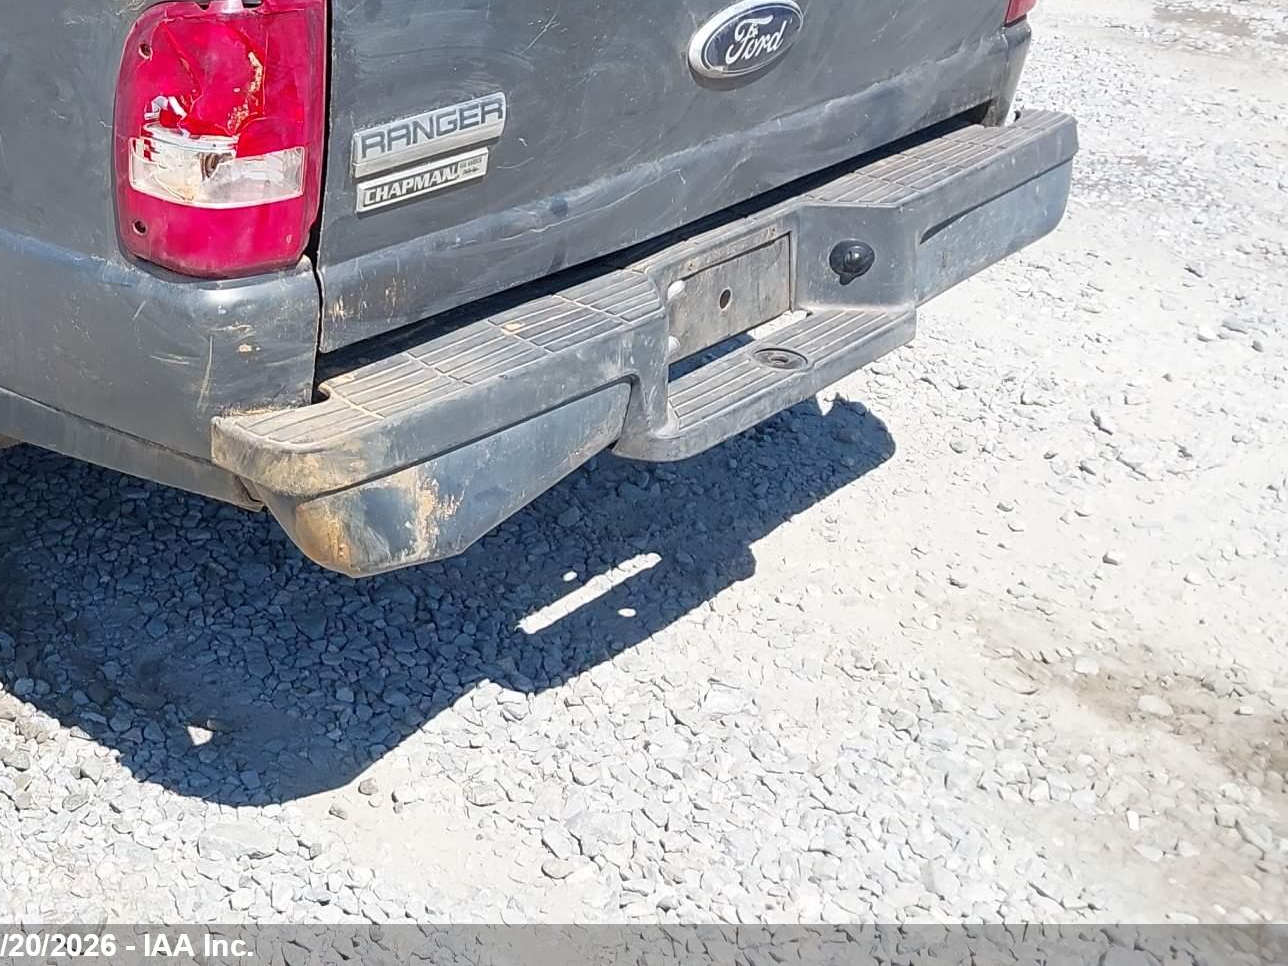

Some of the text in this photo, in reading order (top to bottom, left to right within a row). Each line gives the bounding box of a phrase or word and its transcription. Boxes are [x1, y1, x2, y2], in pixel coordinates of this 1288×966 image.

[725, 14, 787, 65] Ford
[362, 99, 503, 158] RANGER
[364, 165, 460, 206] CHAPMAN
